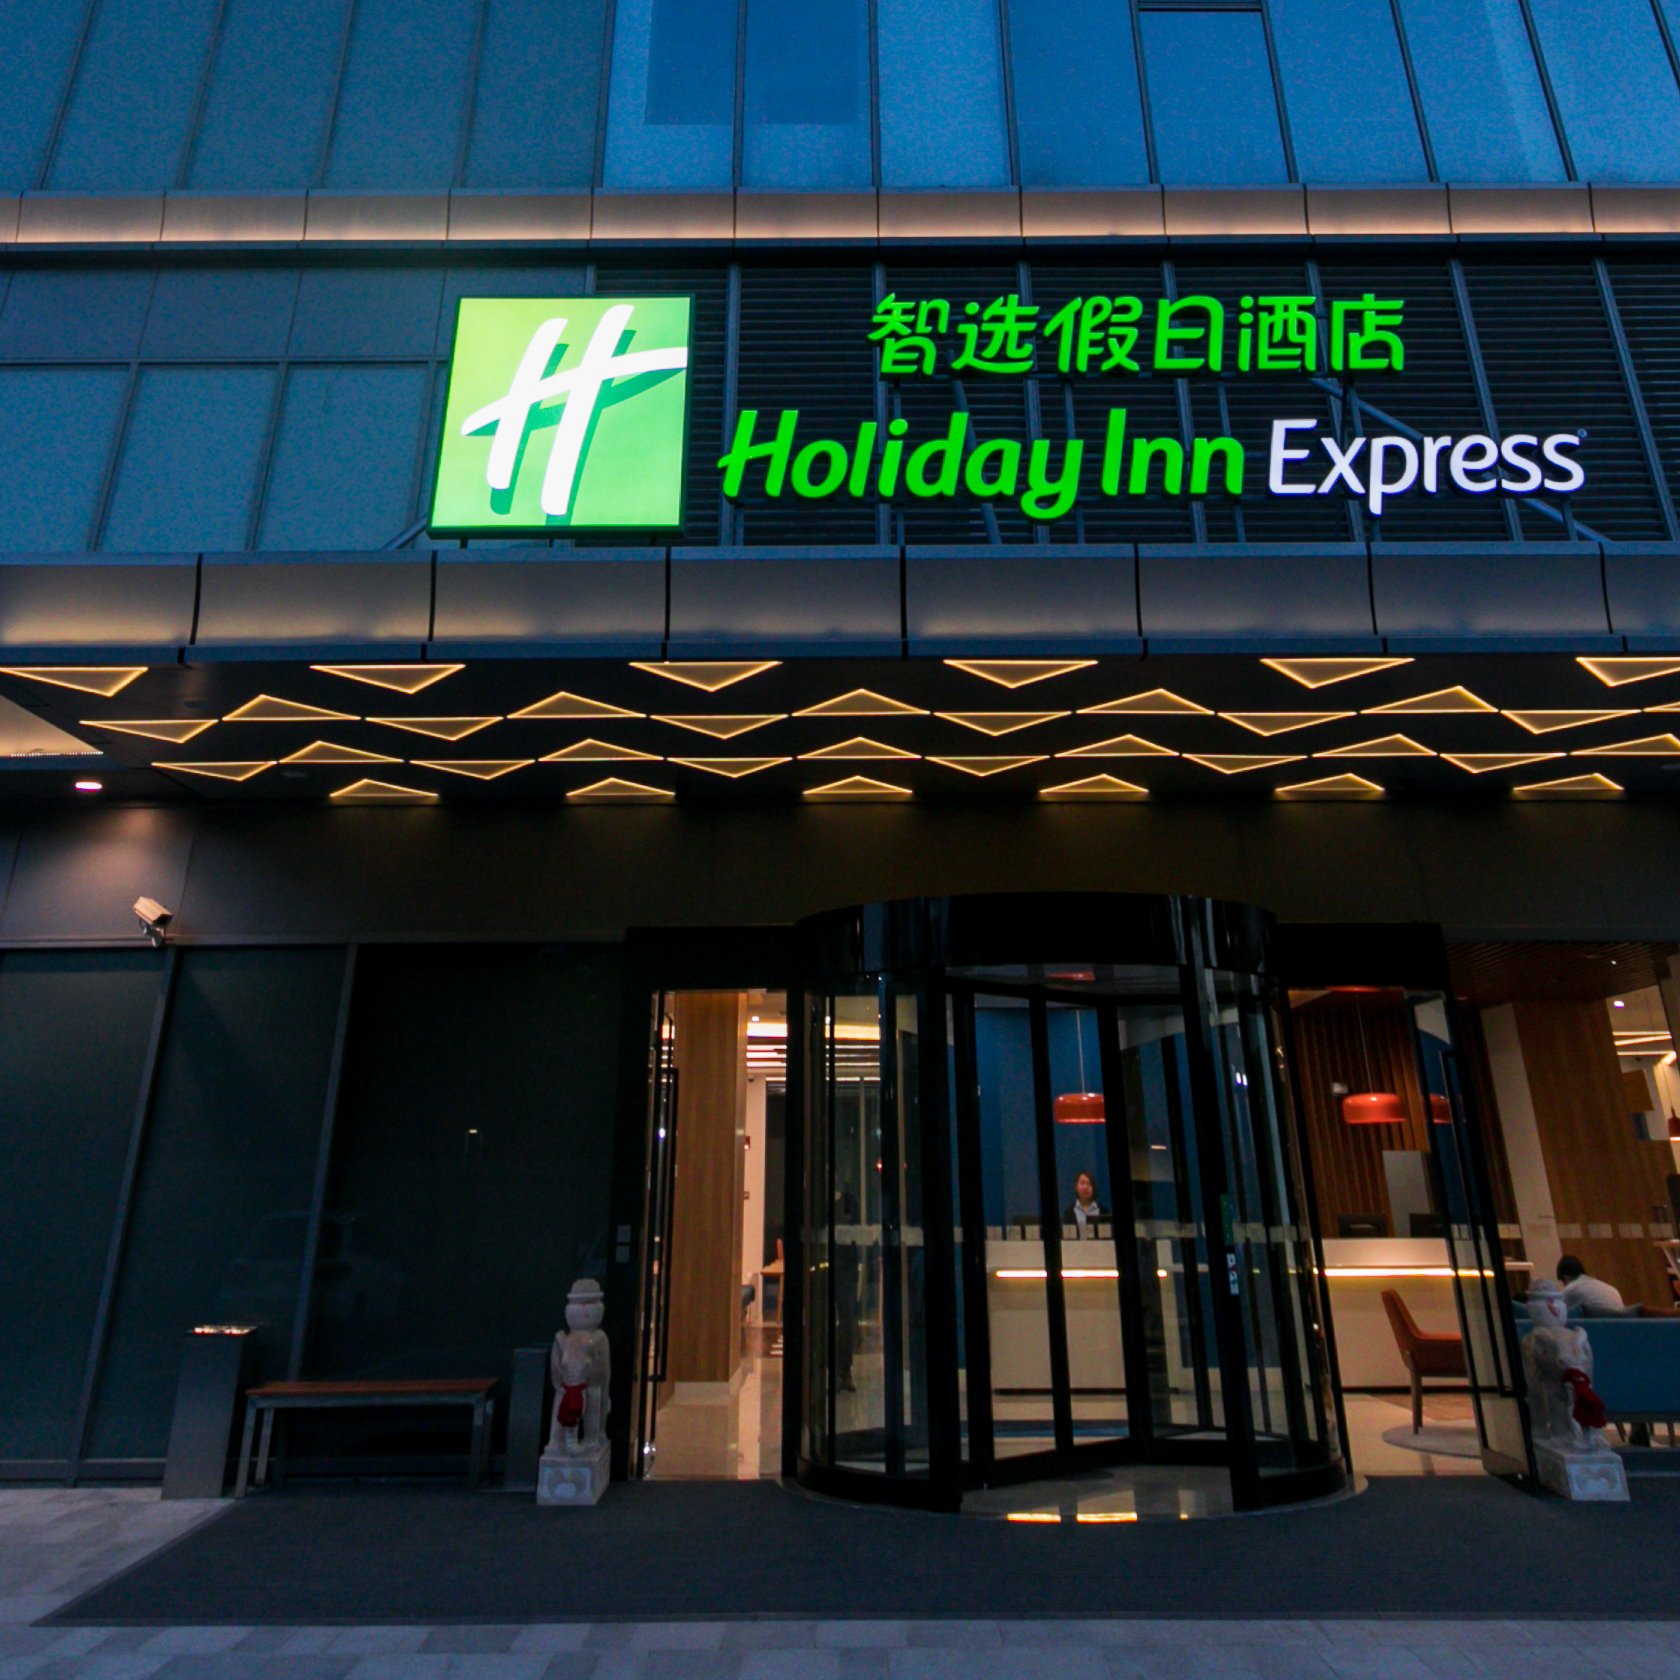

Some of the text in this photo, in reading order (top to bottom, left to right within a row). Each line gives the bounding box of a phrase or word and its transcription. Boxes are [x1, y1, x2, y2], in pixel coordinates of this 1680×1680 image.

[866, 292, 1406, 376] 智选假日酒店
[716, 407, 1585, 519] Holiday Inn Express
